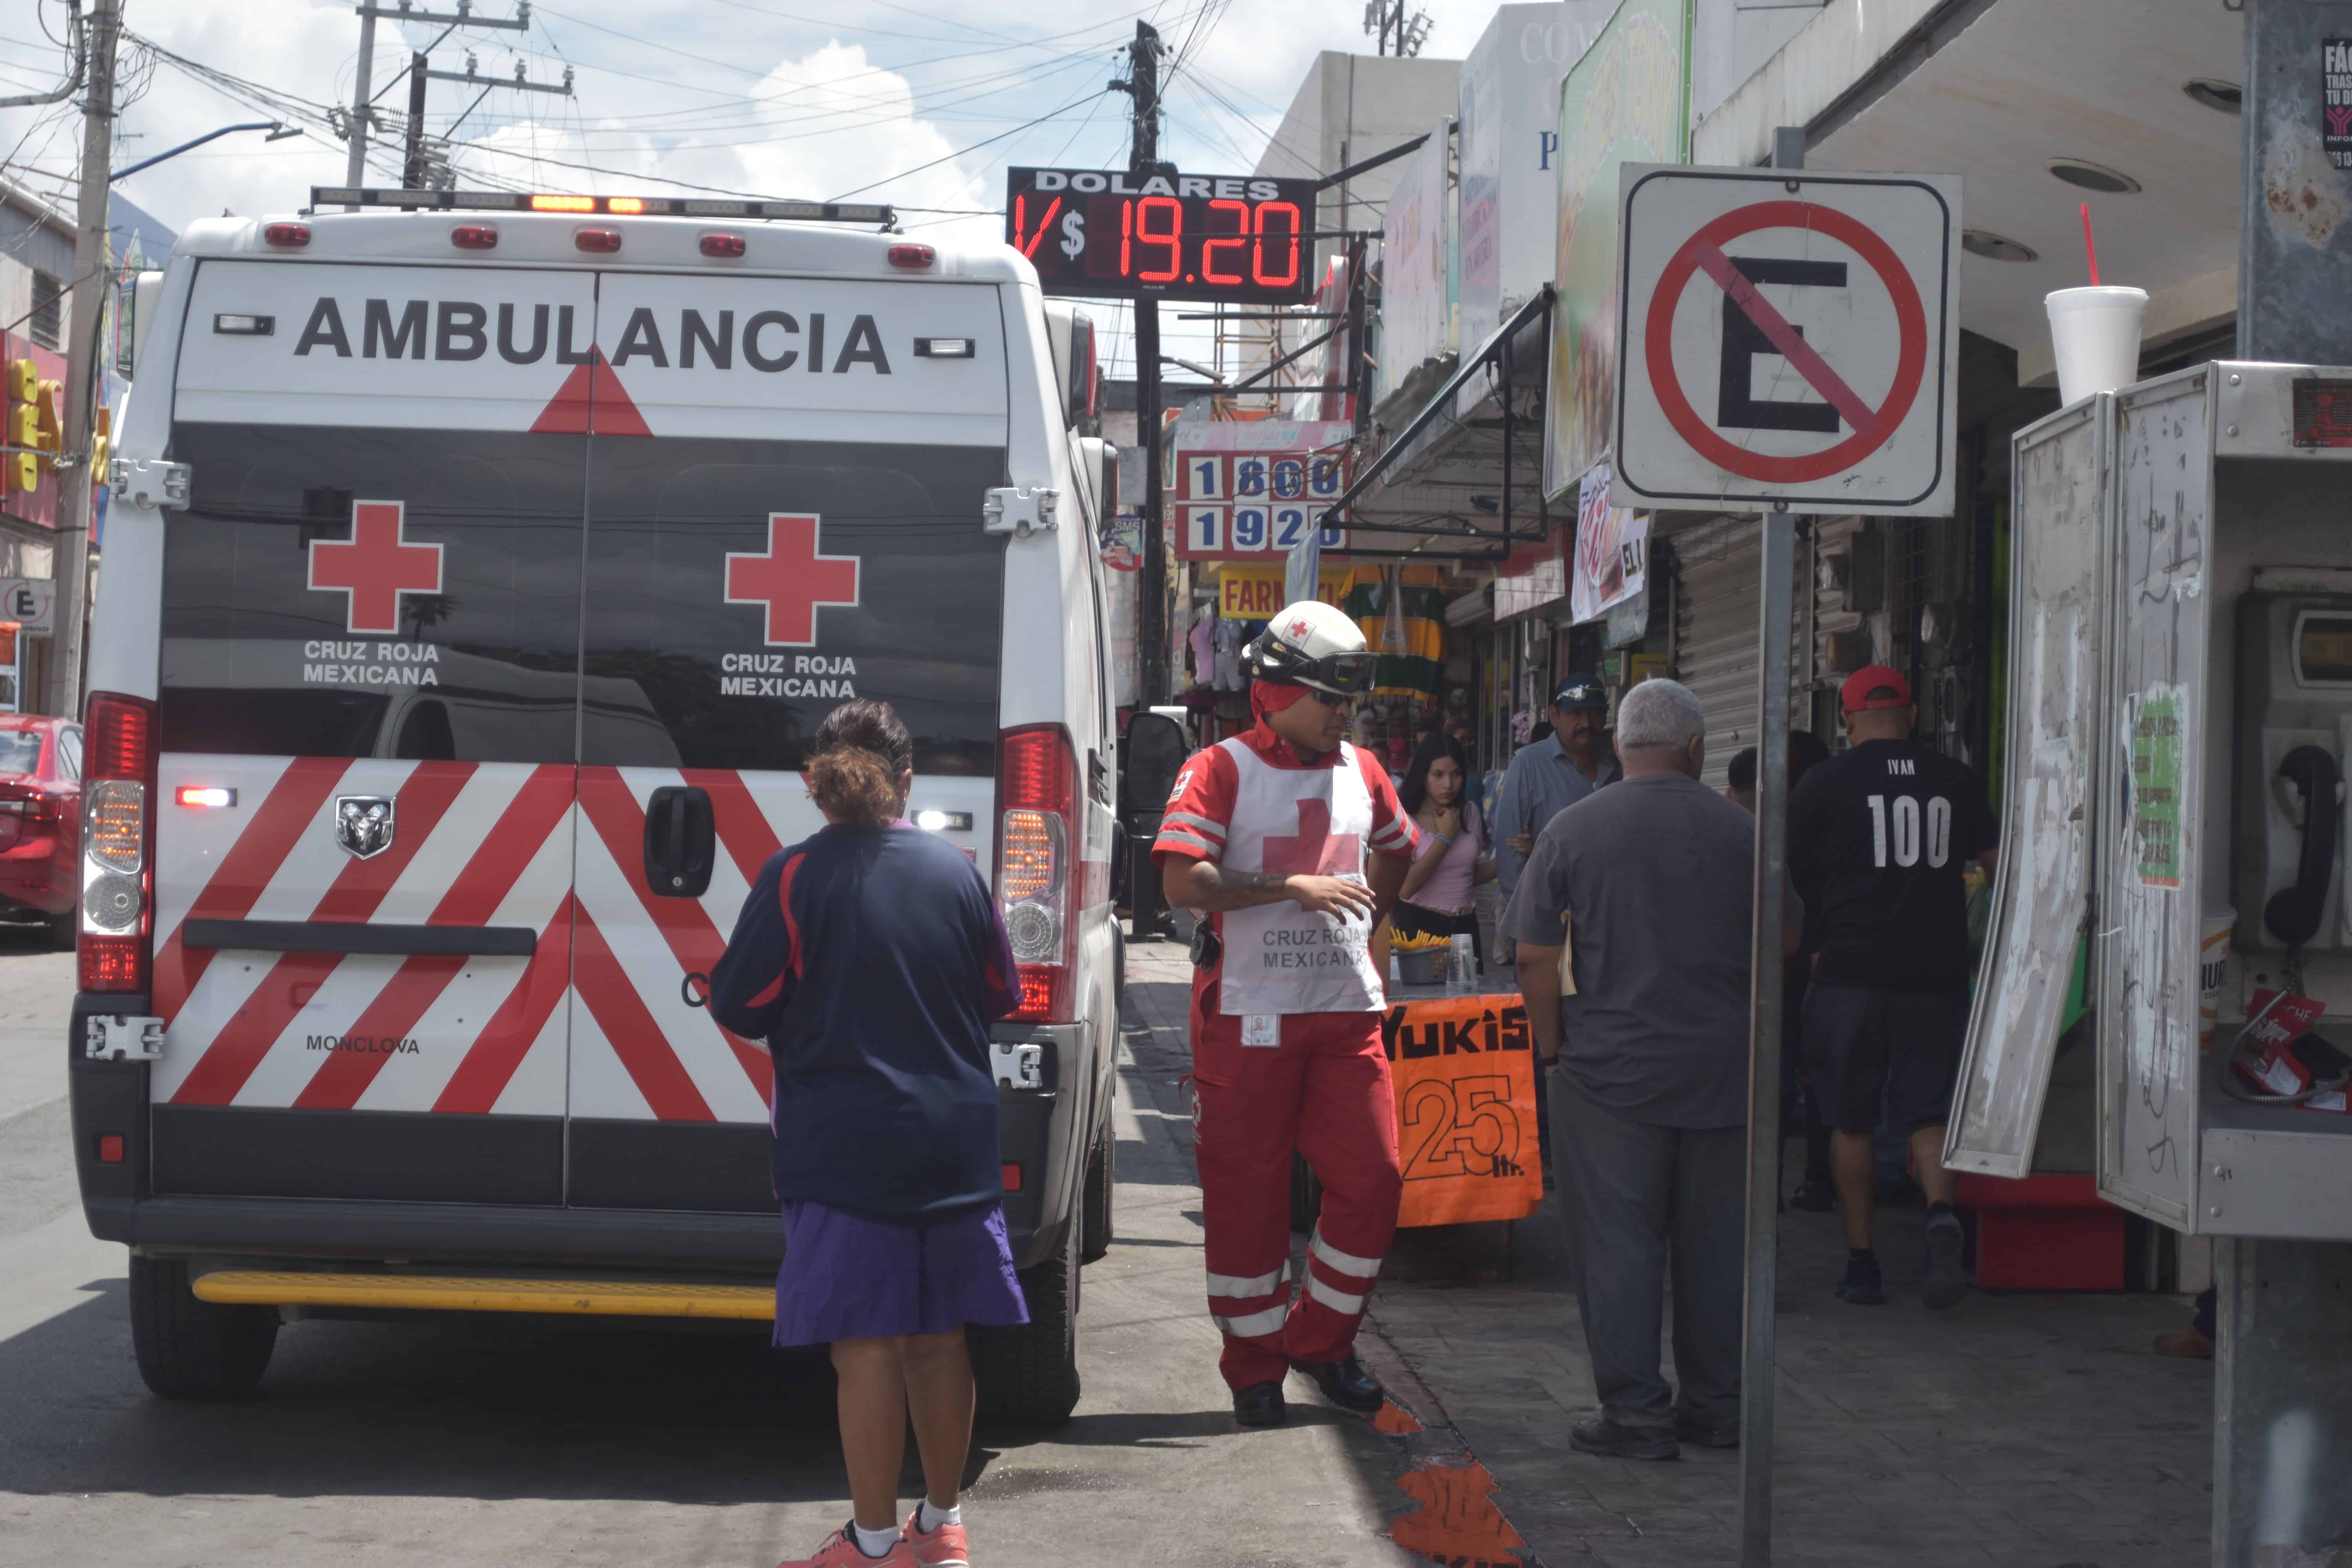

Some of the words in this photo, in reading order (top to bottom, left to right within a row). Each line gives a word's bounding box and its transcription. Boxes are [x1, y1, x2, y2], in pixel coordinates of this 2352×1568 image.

[2327, 90, 2340, 105] TU
[1035, 171, 1279, 200] DOLARES
[1121, 196, 1300, 286] 19.20
[293, 297, 892, 374] AMBULANCIA
[1717, 257, 1847, 433] E
[1116, 521, 1140, 531] SMS
[17, 590, 36, 615] E
[304, 641, 367, 659] CRUZ
[377, 643, 438, 662] ROJA
[722, 653, 784, 673] CRUZ
[795, 656, 856, 674] ROJA
[304, 664, 438, 685] MEXICANA
[721, 677, 855, 698] MEXICANA
[1887, 759, 1915, 775] IVAN
[1867, 795, 1951, 868] 100
[1263, 929, 1316, 945] CRUZ
[1323, 928, 1361, 944] ROJA
[1264, 950, 1363, 967] MEXICANA
[307, 1035, 419, 1054] MONCLOVA
[1402, 1075, 1519, 1181] 25
